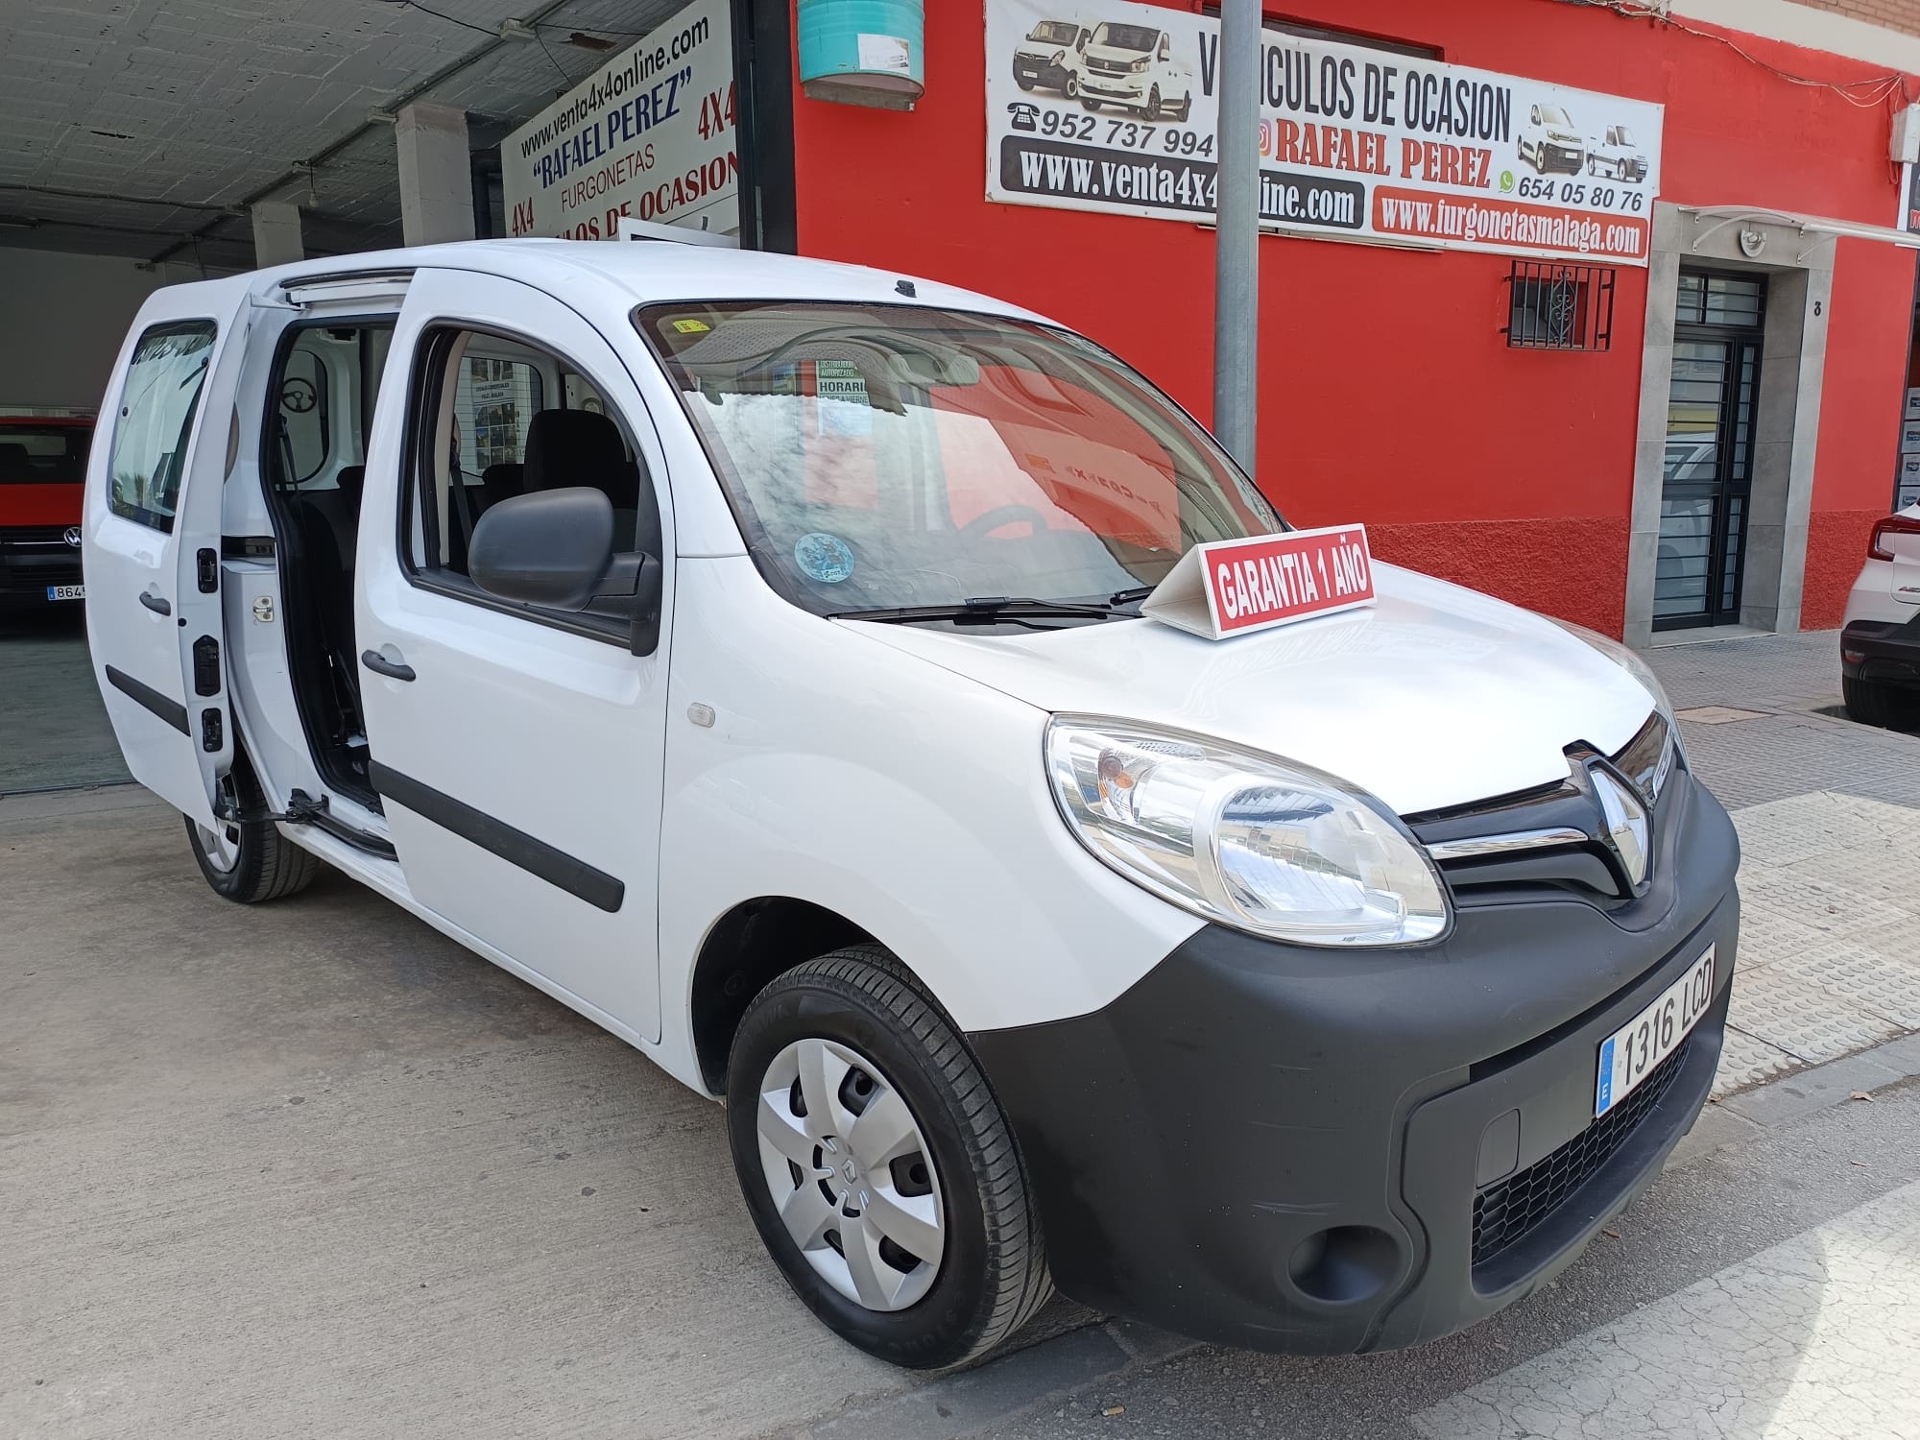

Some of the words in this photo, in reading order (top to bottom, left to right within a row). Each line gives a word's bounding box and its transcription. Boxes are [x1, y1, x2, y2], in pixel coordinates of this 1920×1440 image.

[520, 16, 710, 160] www.venta4x4online.com
[698, 80, 738, 141] 4X4
[1363, 63, 1397, 126] DE
[1403, 70, 1512, 143] OCASION
[1041, 109, 1097, 142] 952
[1106, 119, 1157, 150] 737
[1163, 129, 1214, 157] 994
[1276, 118, 1391, 176] RAFAEL
[1401, 137, 1492, 189] PEREZ
[561, 143, 656, 214] FURGONETAS
[1518, 176, 1555, 201] 654
[1560, 182, 1585, 204] 05
[1590, 187, 1615, 208] 80
[1620, 190, 1643, 212] 76
[512, 197, 534, 237] 4X4
[1381, 195, 1640, 255] www.furgonetasmalaga.com
[820, 382, 866, 392] HORARI
[1217, 552, 1320, 619] GARANTIA
[1317, 548, 1332, 598] 1
[1334, 533, 1368, 596] AÑO
[1625, 997, 1675, 1086] 1316
[1681, 957, 1712, 1031] LCD
[1601, 1082, 1609, 1100] E
